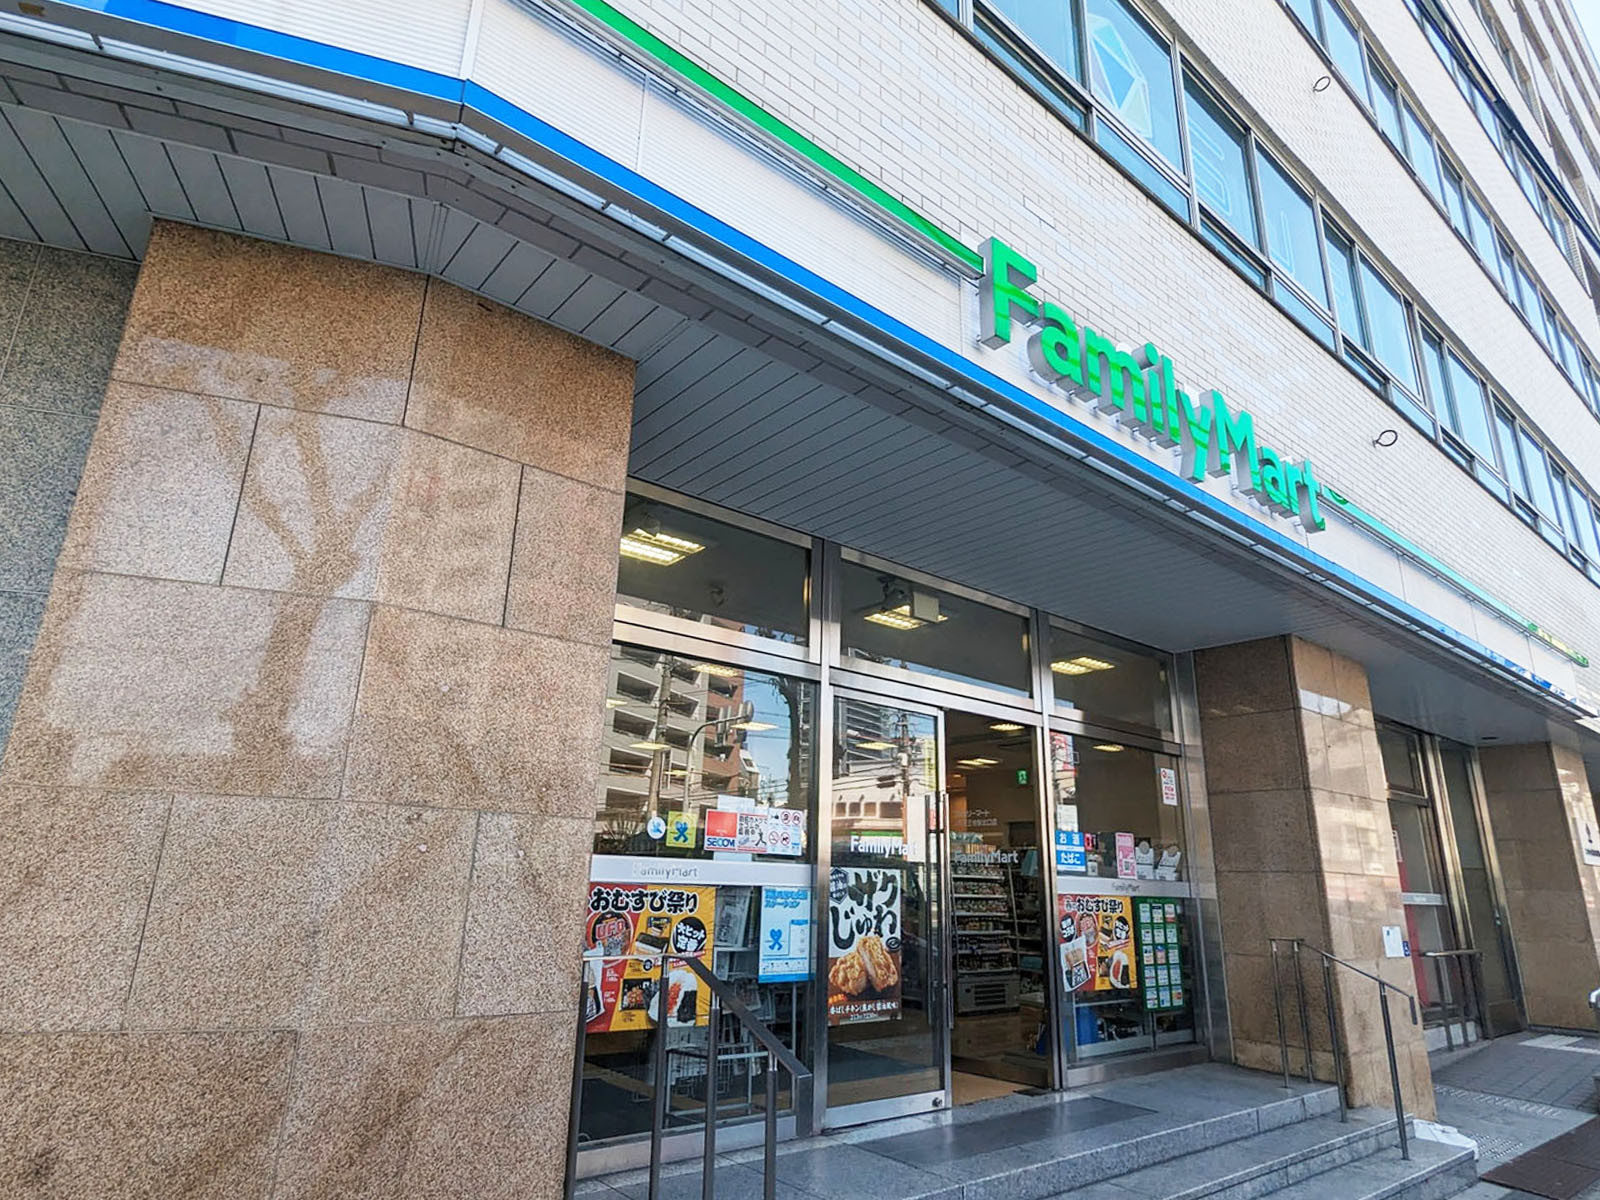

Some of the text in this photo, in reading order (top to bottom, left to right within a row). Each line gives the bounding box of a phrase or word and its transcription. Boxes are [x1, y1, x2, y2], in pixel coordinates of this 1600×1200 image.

[977, 235, 1326, 533] FamilyMart
[706, 837, 736, 848] SECOM
[850, 835, 918, 858] FamilyMa
[954, 850, 1019, 866] FamilyMart
[1061, 852, 1081, 864] たばこ
[848, 869, 898, 912] ザク
[590, 888, 698, 914] おむすび祭り
[677, 922, 705, 940] 大ヒット
